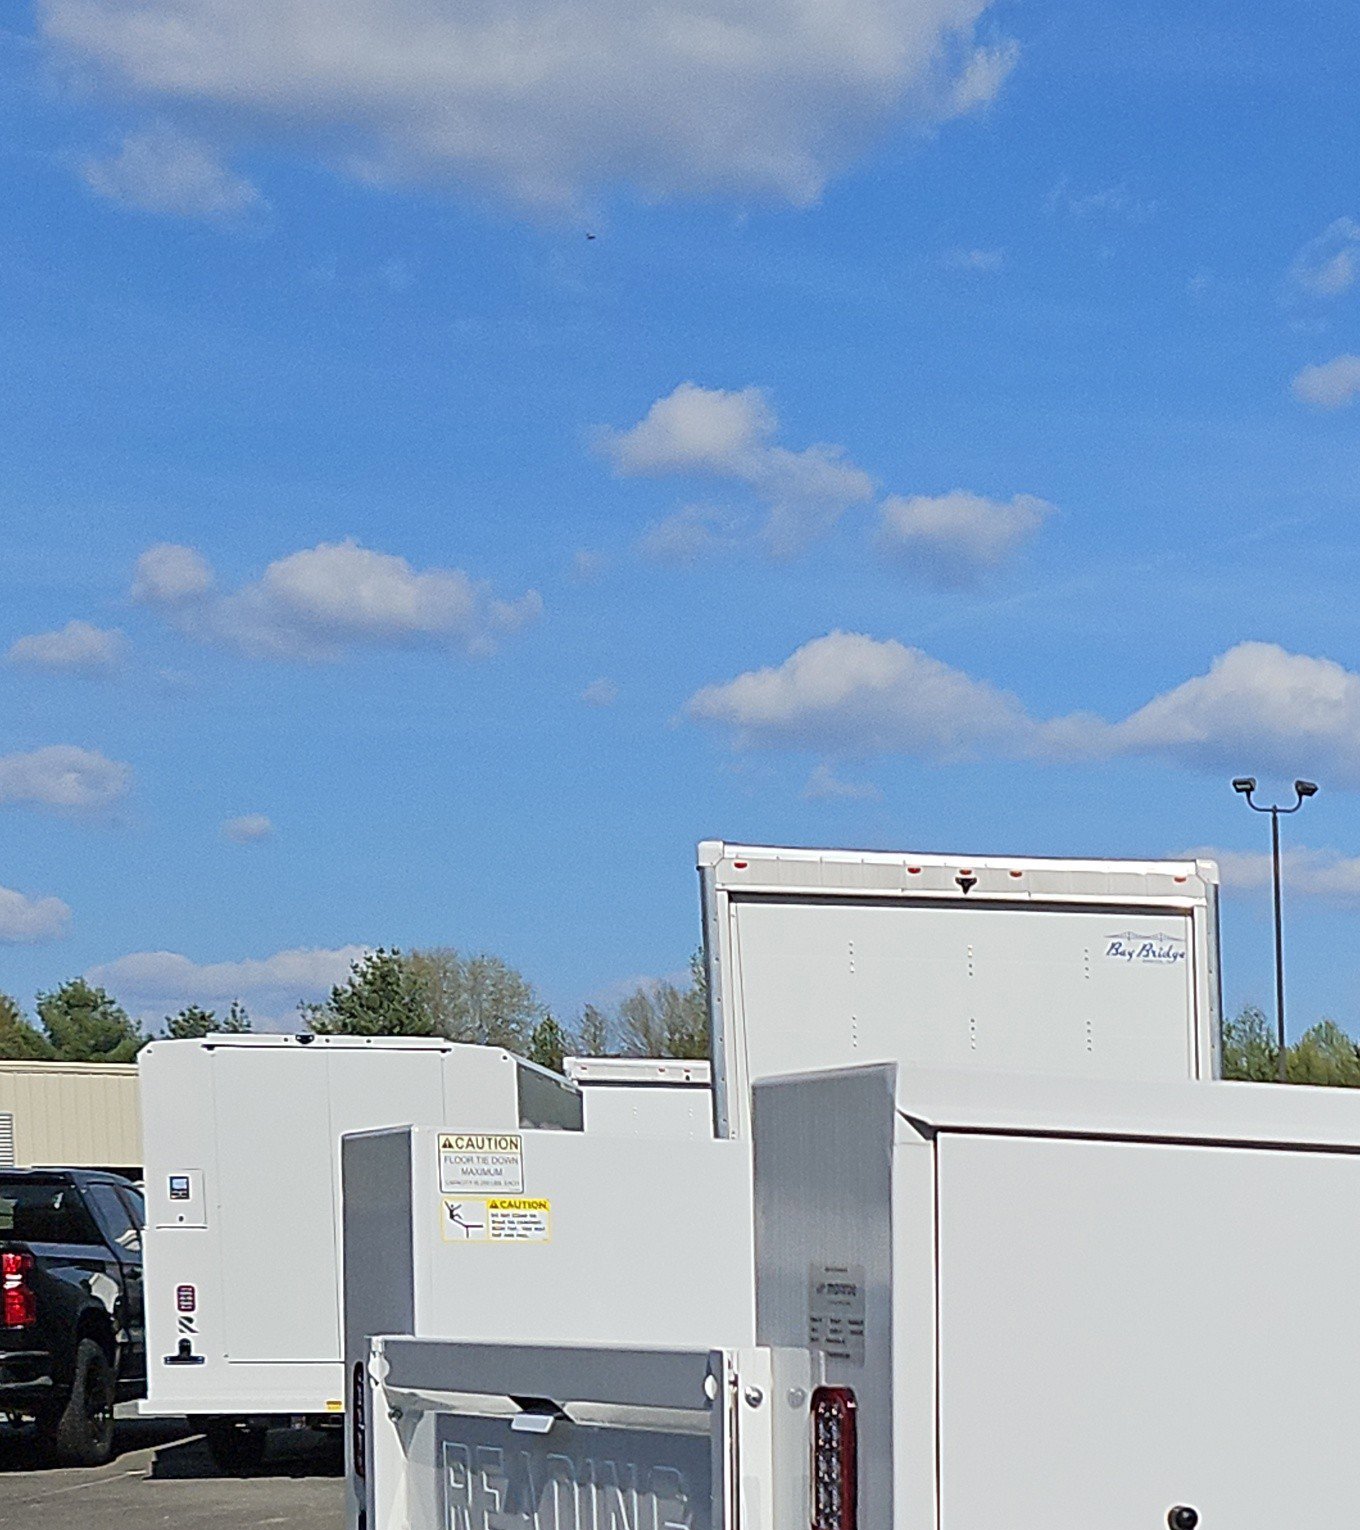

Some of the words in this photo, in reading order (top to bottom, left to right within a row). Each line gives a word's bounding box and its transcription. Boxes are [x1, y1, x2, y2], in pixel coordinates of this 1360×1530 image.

[1106, 941, 1135, 962] Bay
[1137, 943, 1186, 963] Bridge
[455, 1137, 519, 1150] CAUTION
[444, 1155, 474, 1164] FLOOR
[477, 1156, 489, 1165] TIE
[491, 1156, 519, 1165] DOWN
[461, 1167, 503, 1176] MAXIMUM
[500, 1201, 547, 1210] CAUTION
